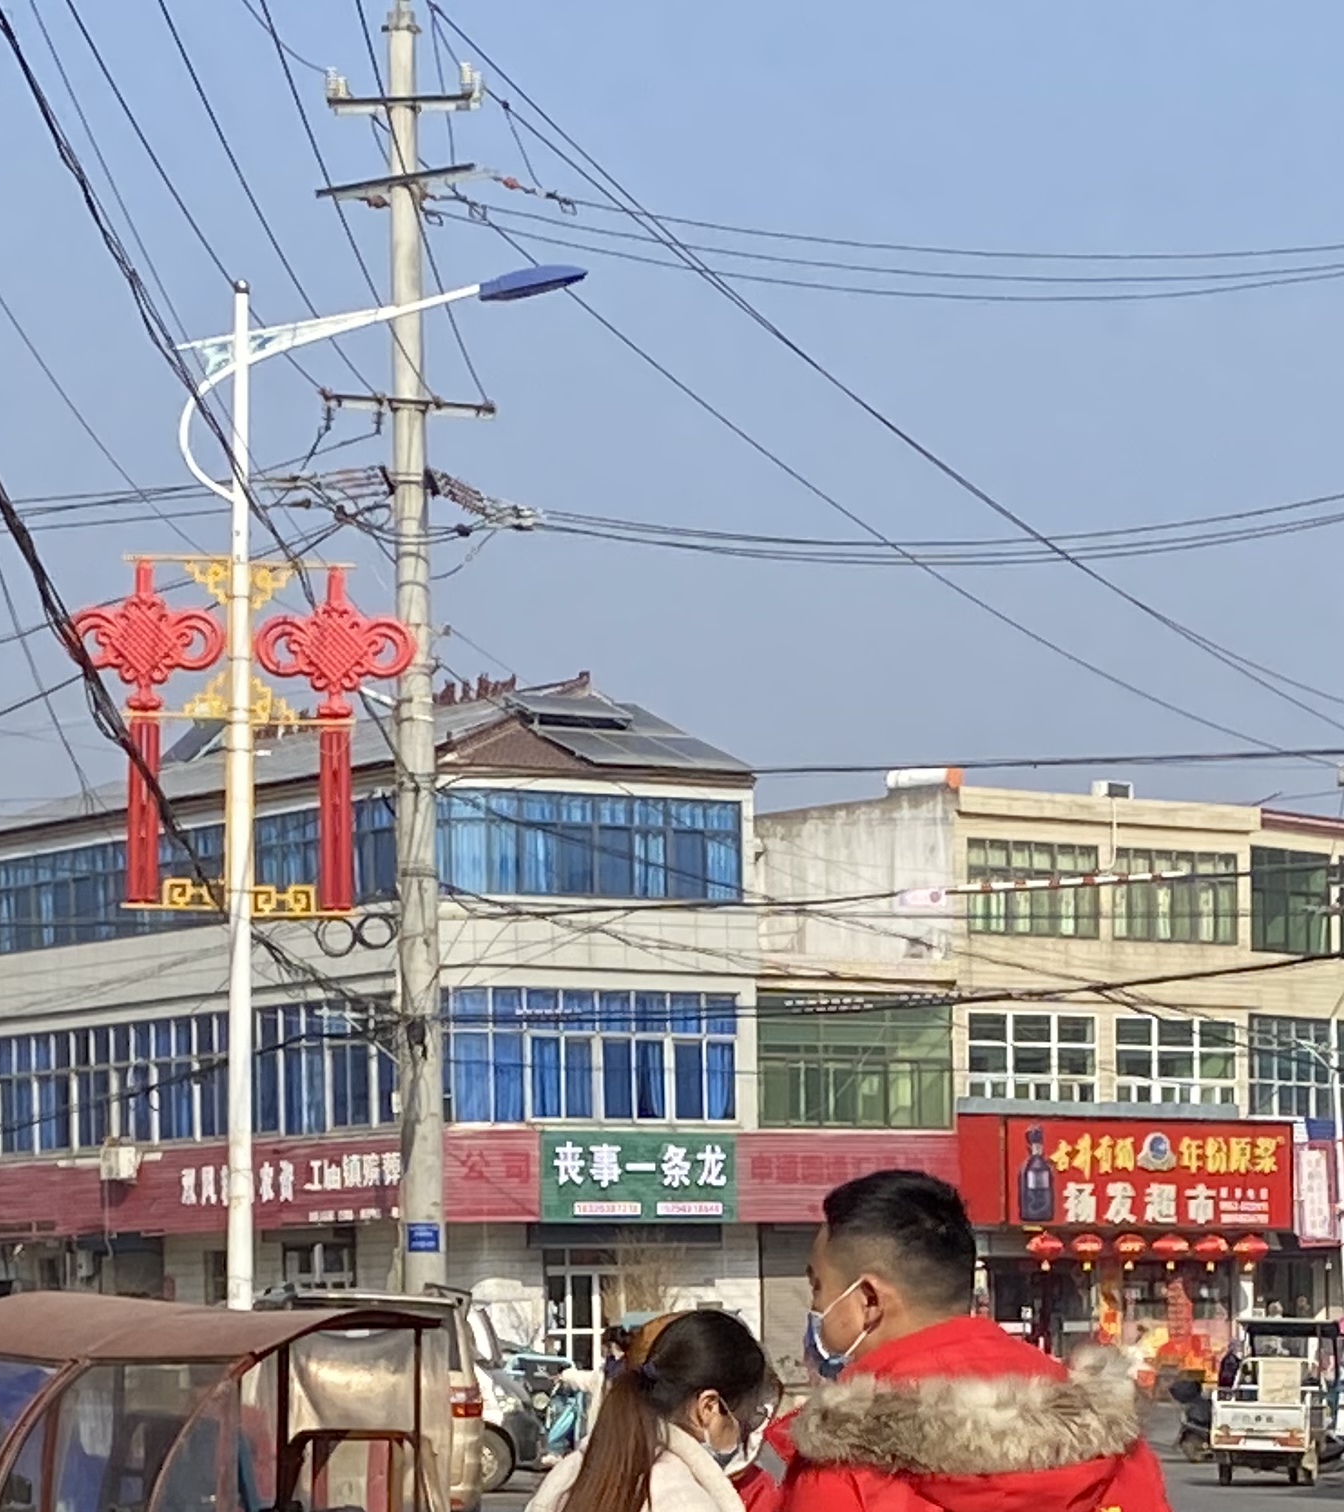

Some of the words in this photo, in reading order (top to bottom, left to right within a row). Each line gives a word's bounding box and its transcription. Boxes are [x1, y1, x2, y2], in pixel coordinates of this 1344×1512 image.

[554, 1141, 726, 1187] 丧事一条龙
